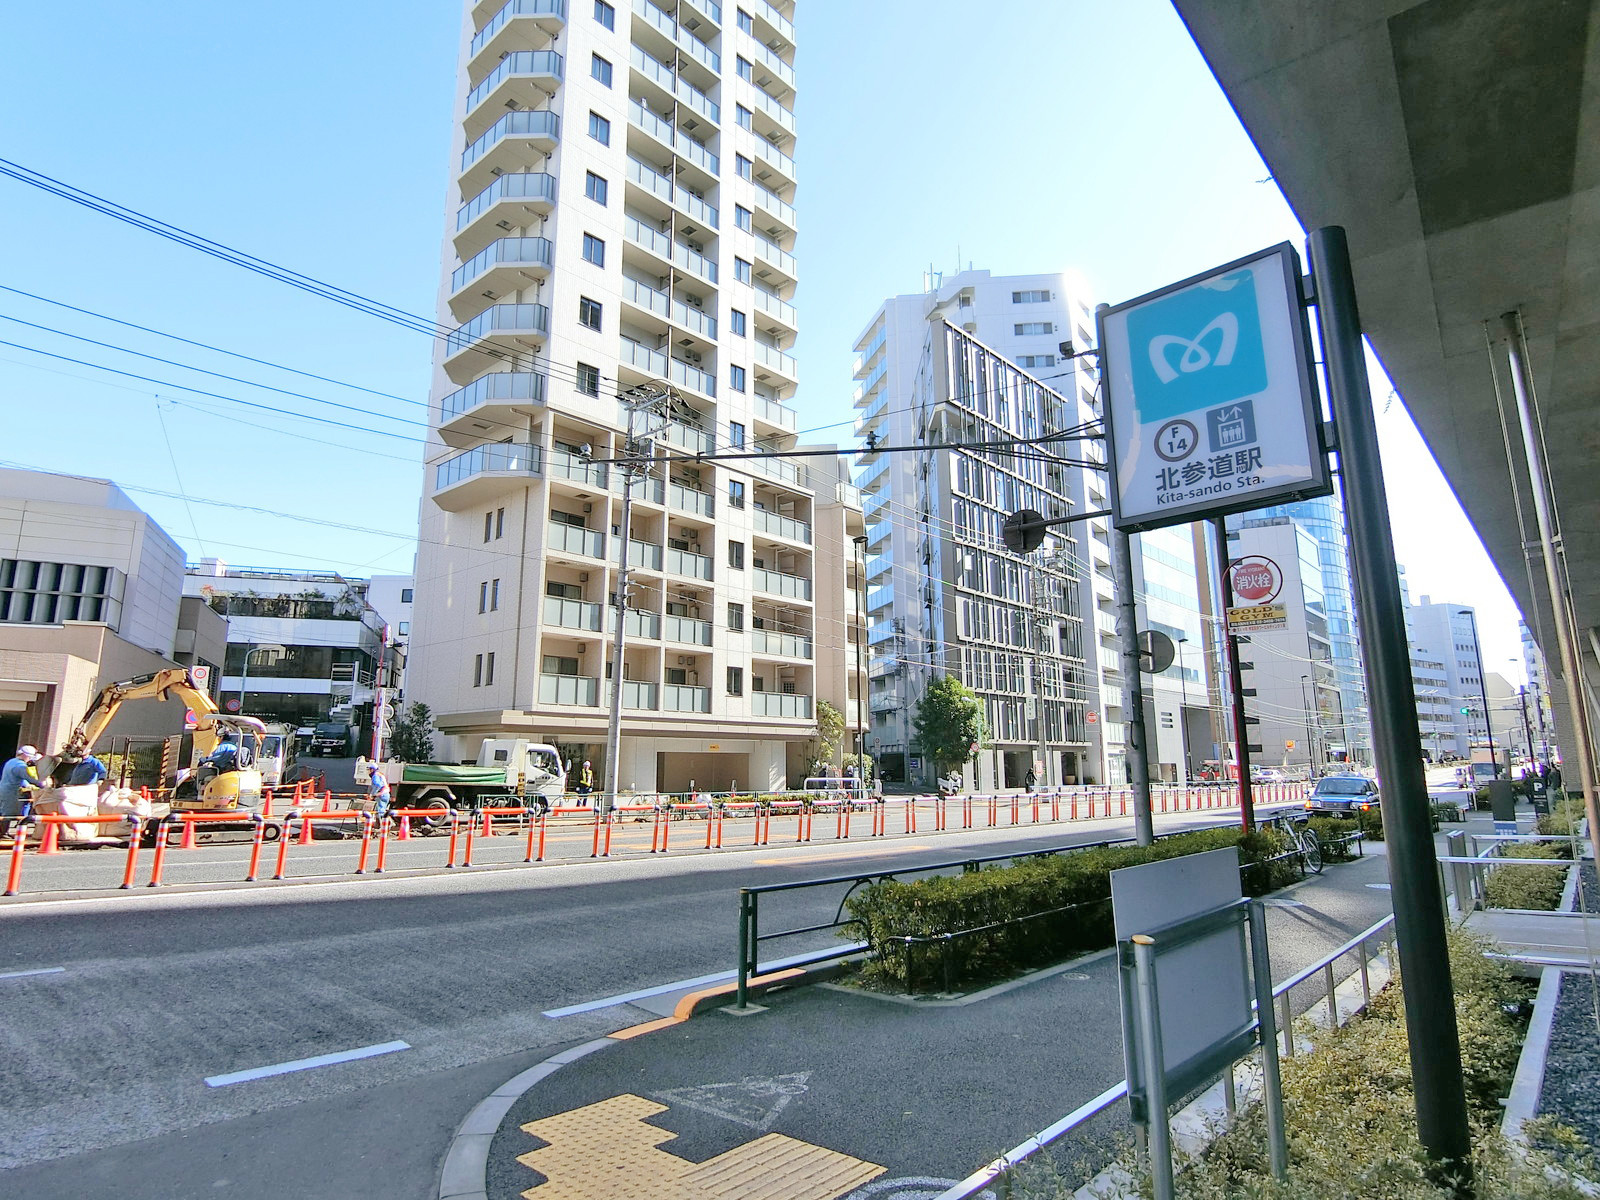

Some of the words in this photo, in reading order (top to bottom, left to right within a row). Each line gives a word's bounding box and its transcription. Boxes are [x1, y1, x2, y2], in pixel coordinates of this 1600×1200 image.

[1171, 427, 1179, 439] F
[1167, 438, 1188, 453] 14
[1155, 446, 1263, 491] 北参道駅
[1157, 481, 1232, 505] Kita-sando
[1237, 475, 1265, 489] Sta.
[1235, 572, 1271, 591] 消火栓
[1240, 612, 1274, 620] GYM
[1533, 782, 1543, 792] P
